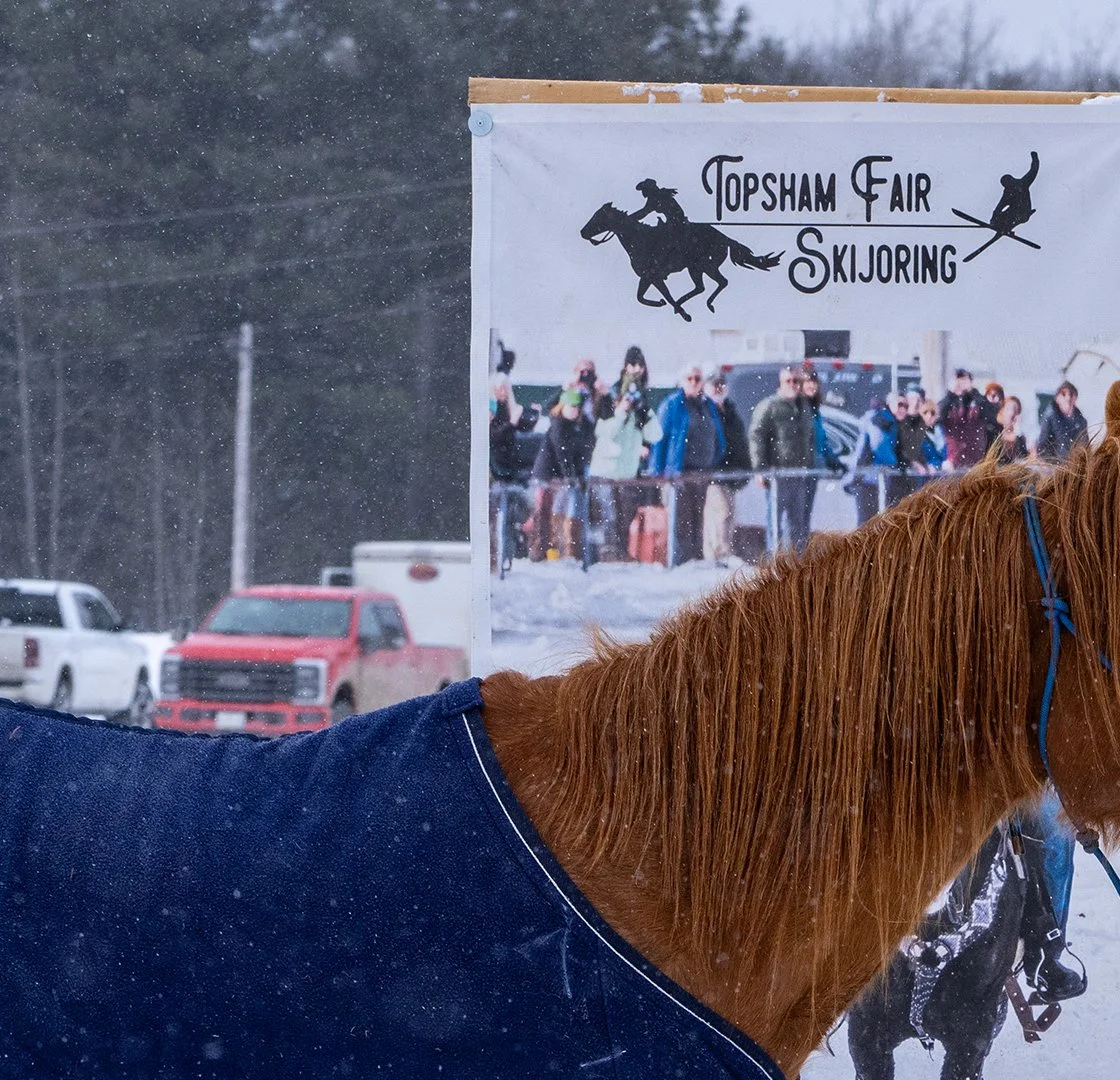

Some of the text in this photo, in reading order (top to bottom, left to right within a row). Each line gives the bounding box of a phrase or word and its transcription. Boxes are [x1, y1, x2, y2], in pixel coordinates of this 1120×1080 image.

[702, 154, 932, 222] TOPSHAM FAIR
[787, 227, 957, 294] SKIJORING
